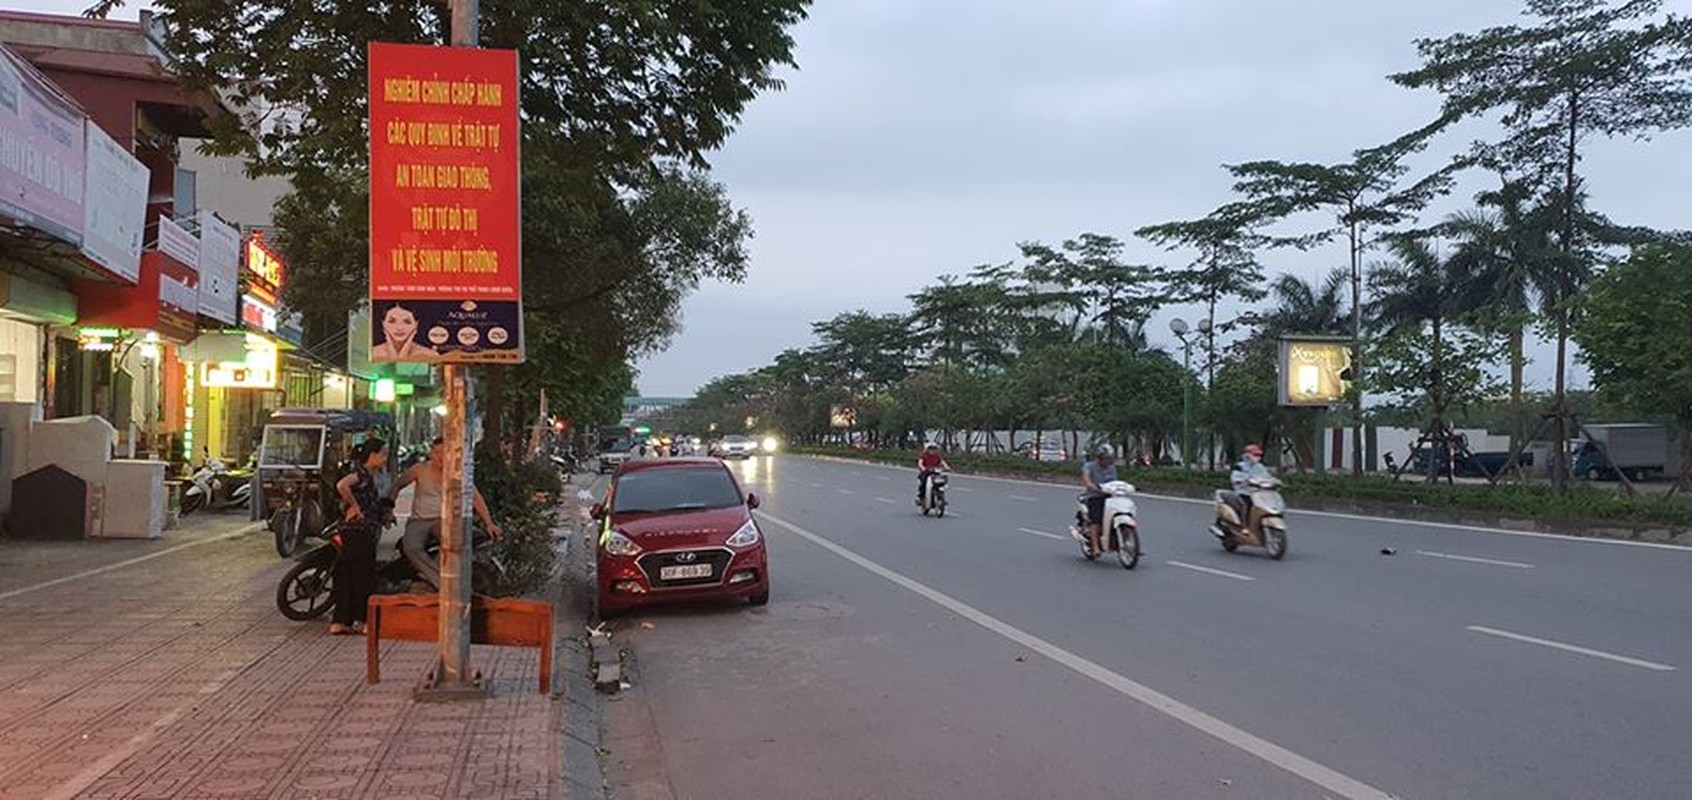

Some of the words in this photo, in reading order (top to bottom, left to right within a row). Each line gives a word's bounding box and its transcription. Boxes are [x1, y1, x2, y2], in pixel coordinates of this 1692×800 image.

[384, 75, 420, 103] NGHIÊM
[421, 72, 450, 104] CHỈNH
[451, 74, 476, 106] CHẤP
[477, 78, 502, 107] HÀNH
[387, 117, 407, 145] CÁC
[408, 122, 426, 147] QUY
[428, 123, 450, 151] ĐỊNH
[451, 117, 463, 147] VỀ
[464, 120, 486, 153] TRẬT
[487, 123, 500, 153] TỰ
[396, 165, 410, 188] AN
[411, 161, 435, 188] TOÀN
[436, 165, 459, 189] GIAO
[459, 161, 492, 192] THÔNG,
[411, 203, 433, 235] TRẬT
[435, 206, 448, 235] TỰ
[448, 203, 462, 230] ĐÔ
[463, 208, 478, 237] THỊ
[392, 243, 405, 272] VÀ
[405, 244, 418, 278] VỆ
[418, 249, 442, 272] SINH
[442, 245, 461, 273] MÔI
[462, 244, 498, 273] TRƯỜNG
